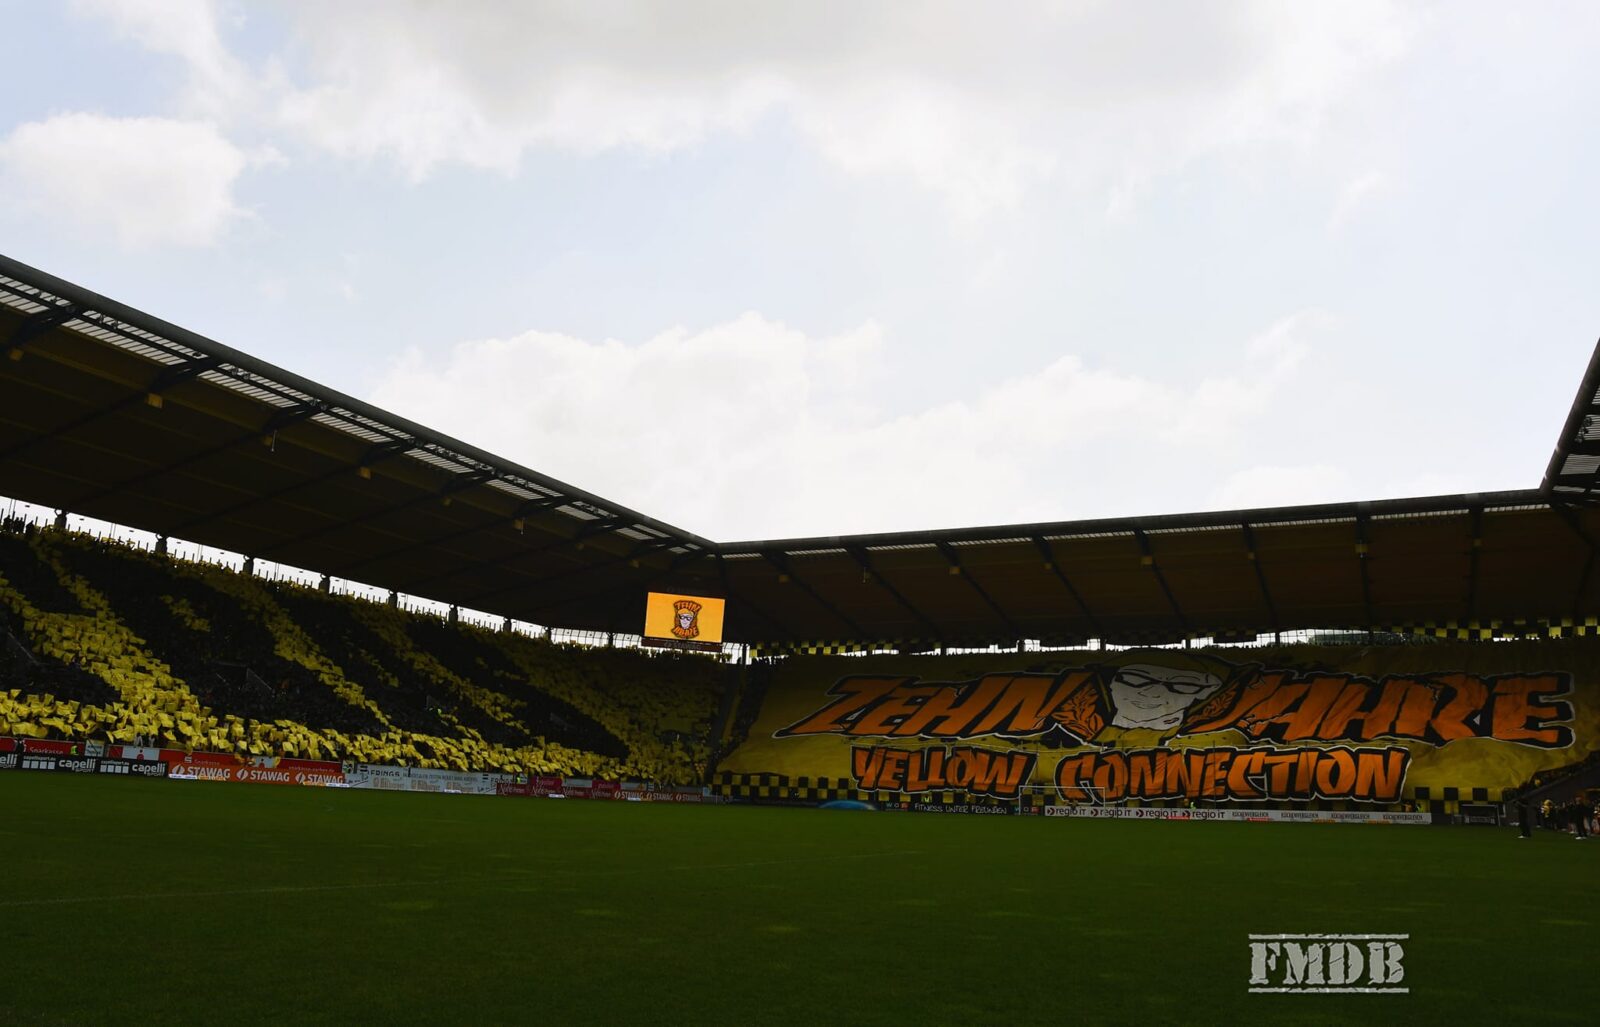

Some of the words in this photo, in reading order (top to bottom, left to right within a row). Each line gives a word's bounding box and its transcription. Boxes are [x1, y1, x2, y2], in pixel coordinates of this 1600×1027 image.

[774, 669, 1094, 739] ZEHN
[1186, 670, 1573, 747] JAHRE
[58, 758, 97, 771] capelli
[131, 762, 166, 775] capelli
[187, 766, 231, 780] STAWAG
[249, 769, 290, 782] STAWAG
[308, 773, 344, 784] STAWAG
[852, 746, 1035, 798] YELLOW
[1055, 747, 1408, 803] CONNECTION
[914, 803, 943, 812] FITNESS
[945, 804, 969, 813] UNTER
[971, 804, 1008, 814] FREUNDEN
[1056, 807, 1078, 817] regio
[1145, 808, 1169, 819] regio
[1192, 809, 1217, 820] regio
